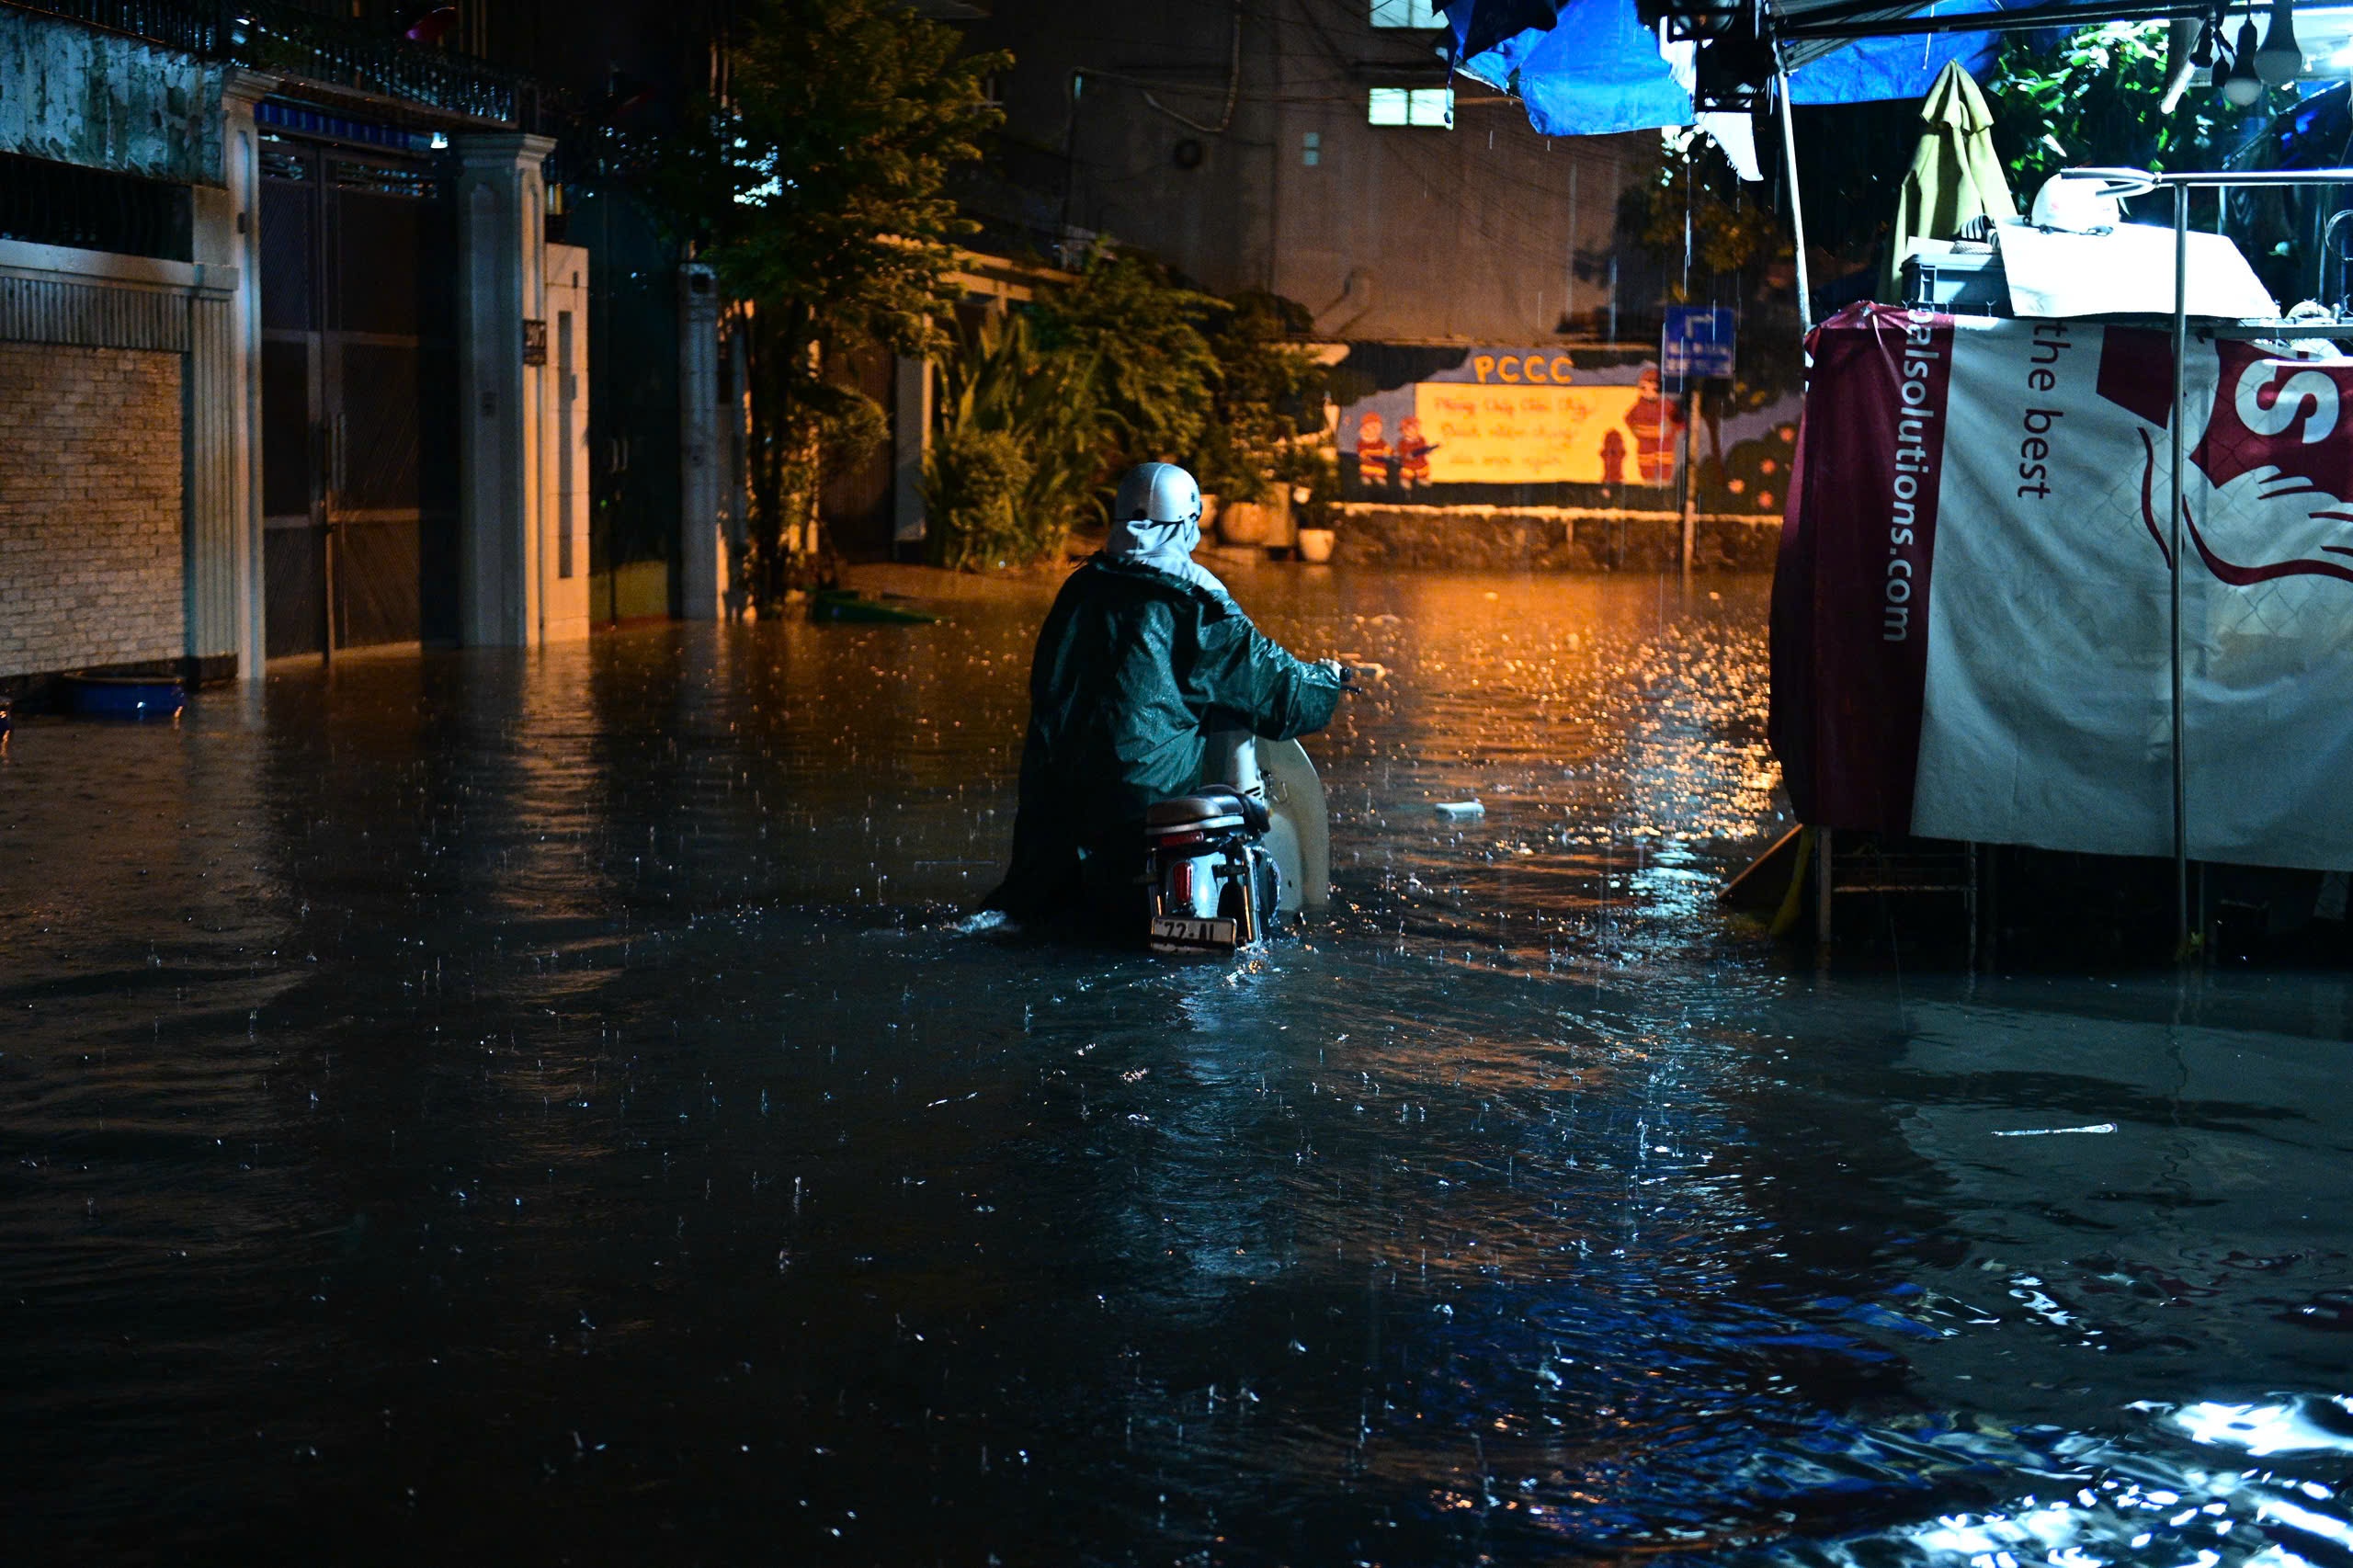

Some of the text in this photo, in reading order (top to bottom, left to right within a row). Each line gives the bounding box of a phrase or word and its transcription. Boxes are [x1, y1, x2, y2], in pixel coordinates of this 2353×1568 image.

[1472, 355, 1574, 383] PCCC
[2018, 319, 2071, 500] the best
